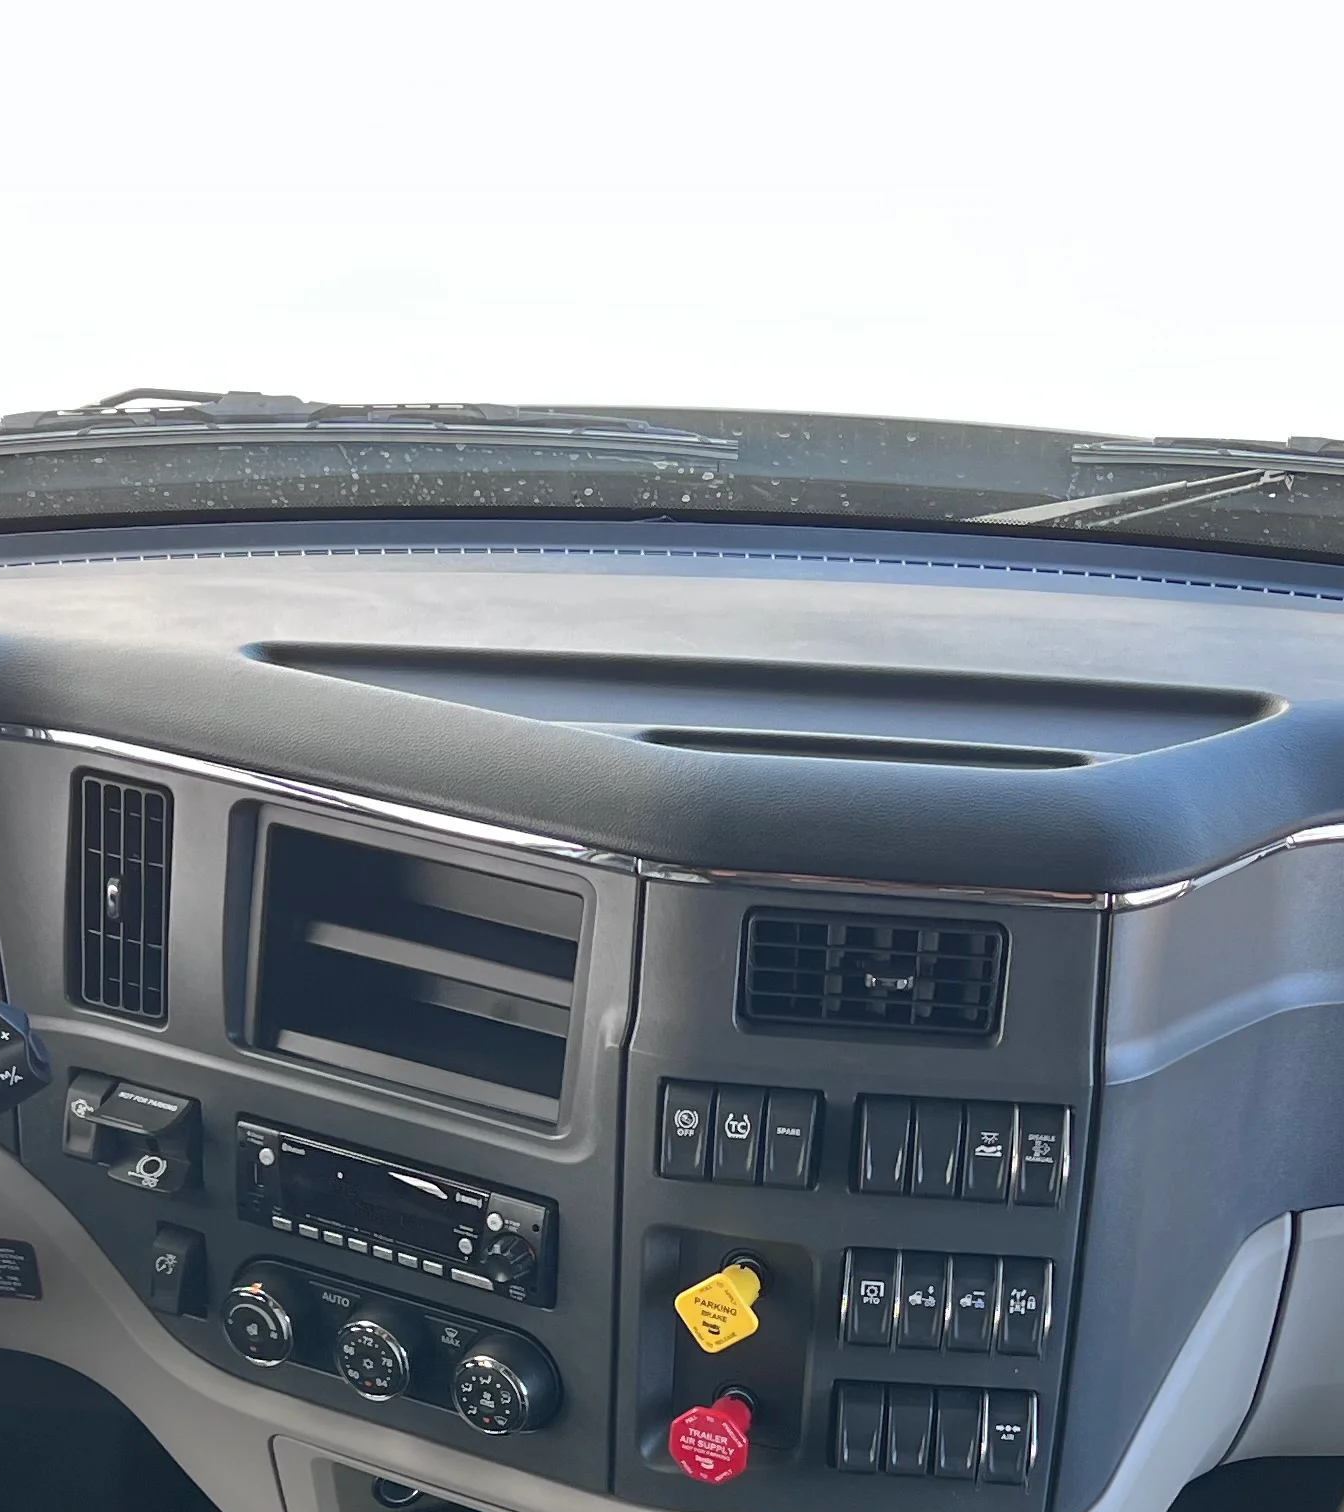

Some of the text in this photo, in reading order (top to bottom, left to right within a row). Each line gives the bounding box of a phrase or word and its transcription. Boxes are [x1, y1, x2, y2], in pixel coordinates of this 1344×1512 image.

[118, 1091, 178, 1112] NOT FOR PARKING
[676, 1128, 695, 1137] OFF
[729, 1121, 748, 1134] TC
[776, 1127, 801, 1136] SPARE
[321, 1291, 351, 1308] AUTO
[863, 1297, 881, 1305] PTO
[693, 1296, 738, 1317] PARKING
[700, 1309, 728, 1323] BRAKE
[362, 1335, 374, 1347] 72
[441, 1335, 461, 1348] MAX
[688, 1427, 728, 1445] TRAILER
[679, 1435, 735, 1456] AIR SUPPLY
